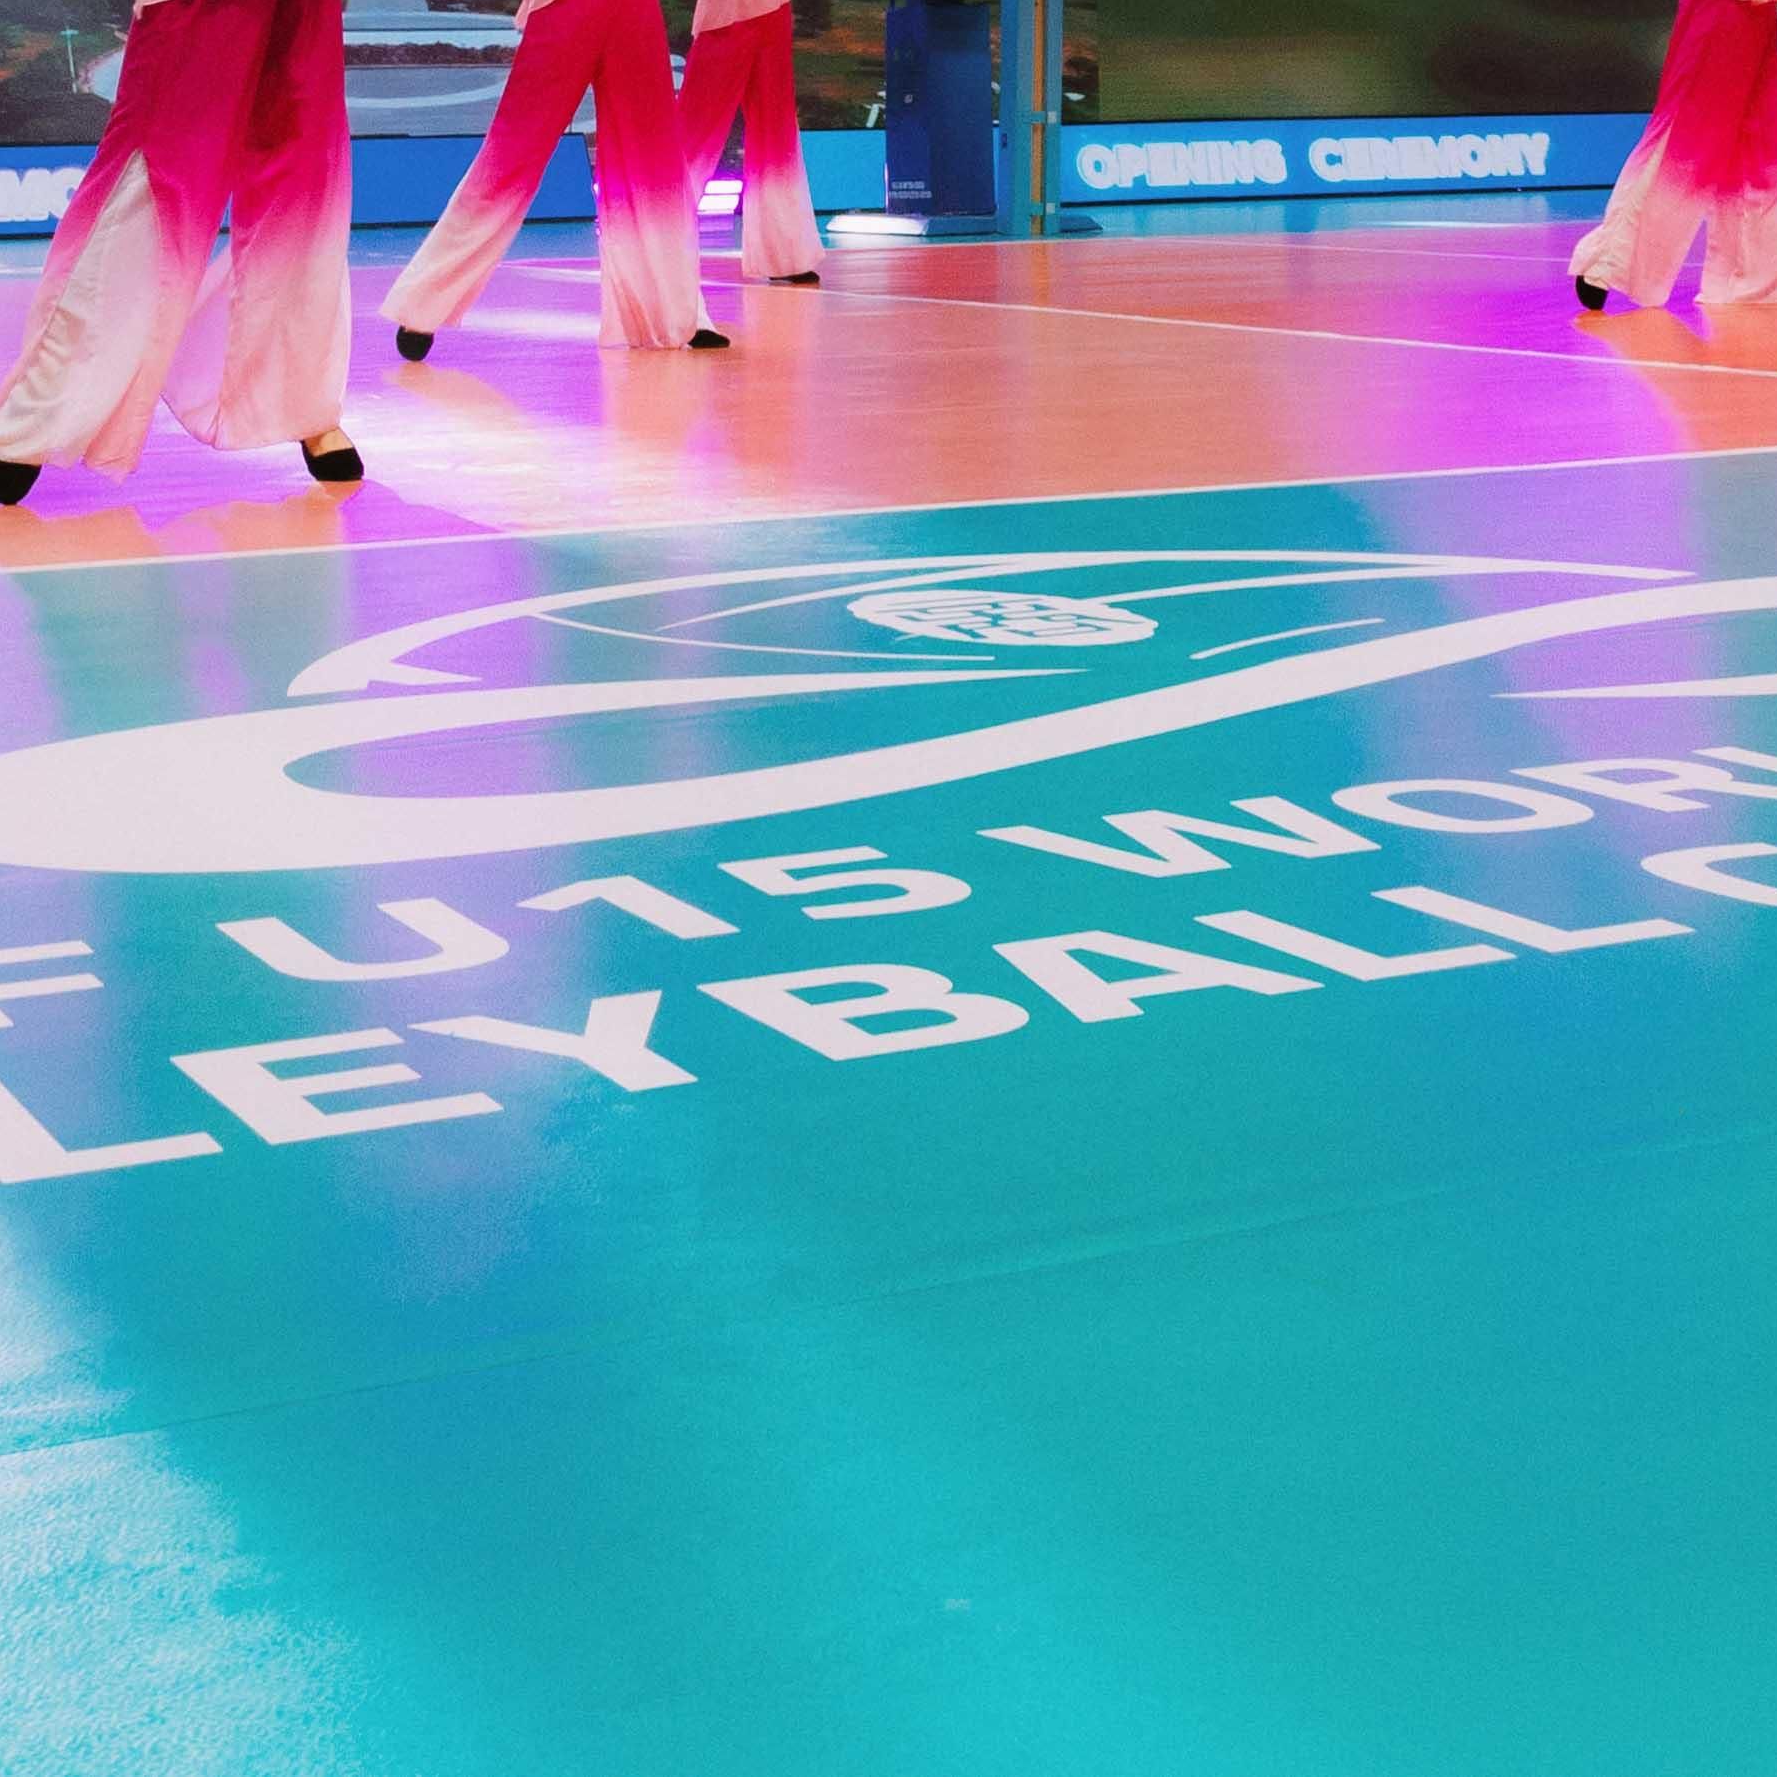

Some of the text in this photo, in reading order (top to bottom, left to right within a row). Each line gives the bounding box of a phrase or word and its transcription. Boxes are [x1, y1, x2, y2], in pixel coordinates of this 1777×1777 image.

[1077, 133, 1550, 189] OPENING CEREMONY
[216, 845, 972, 982] U15
